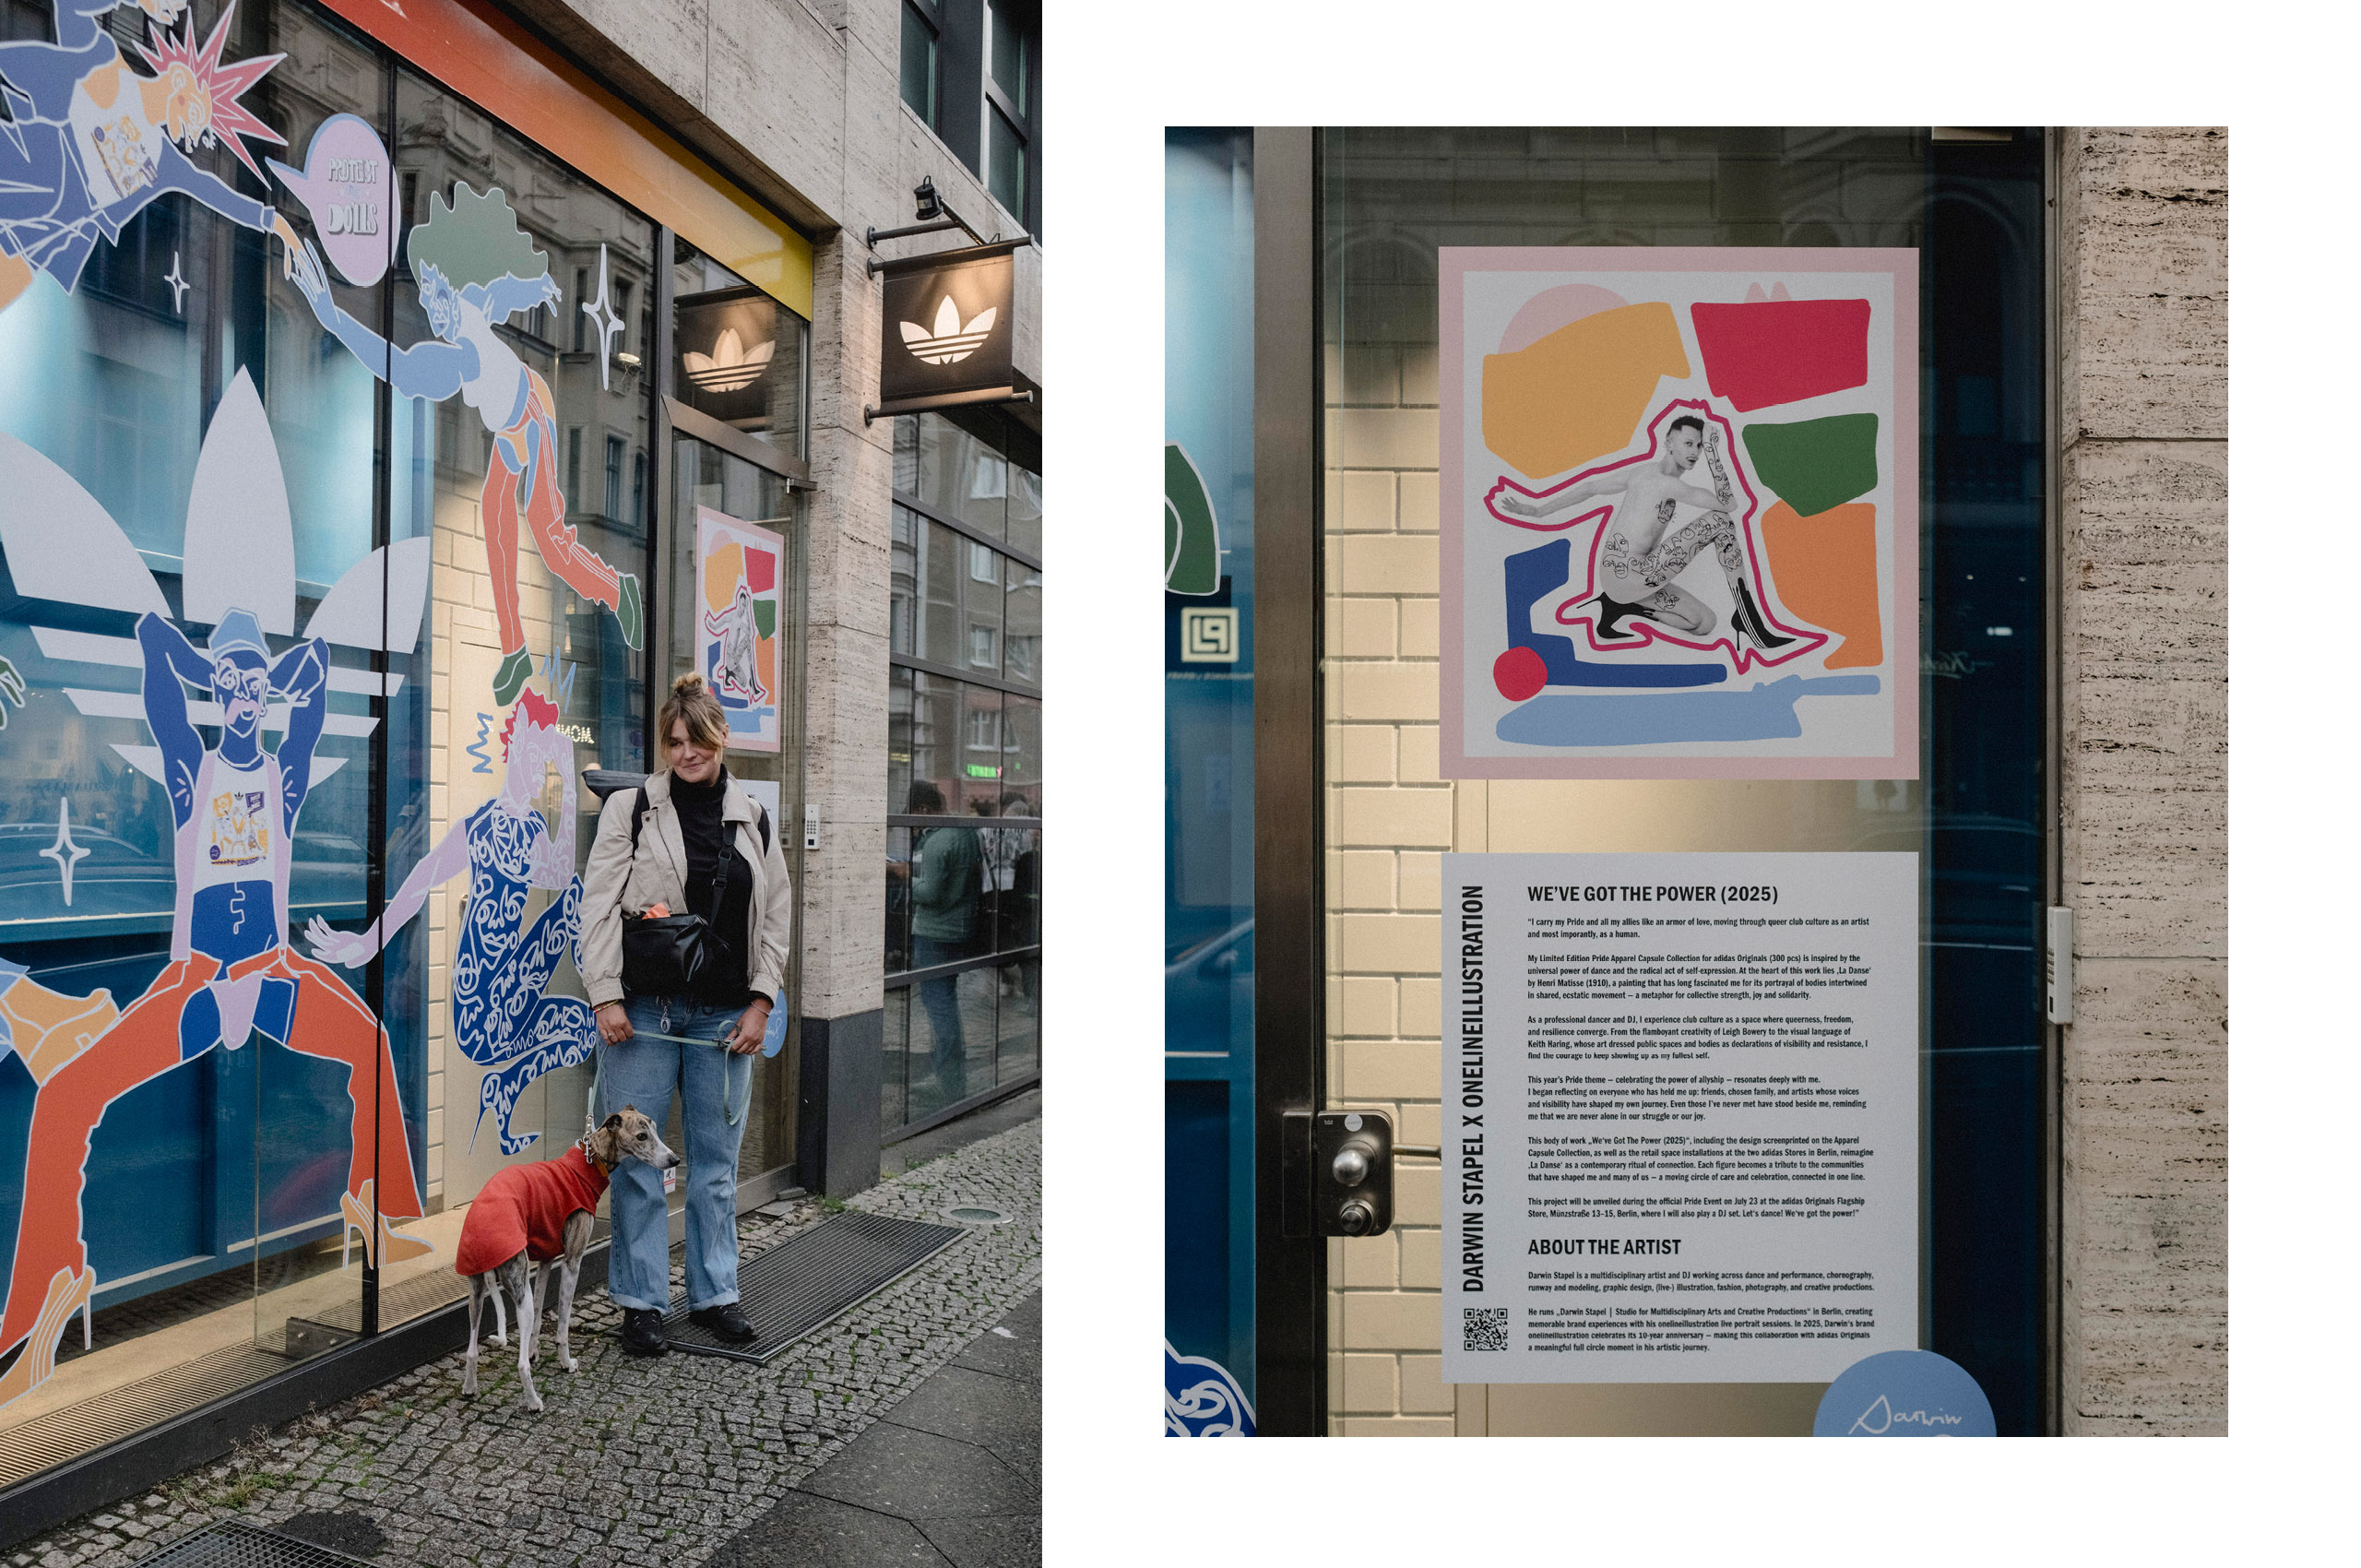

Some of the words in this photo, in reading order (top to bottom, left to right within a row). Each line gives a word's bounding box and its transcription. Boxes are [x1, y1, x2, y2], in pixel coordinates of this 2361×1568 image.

[328, 156, 378, 184] PROTECT
[327, 201, 378, 234] DOLLS
[1527, 886, 1580, 901] WE’VE
[1584, 886, 1618, 901] GOT
[1619, 886, 1653, 901] THE
[1656, 886, 1716, 901] POWER
[1721, 886, 1778, 905] (2025)
[1713, 918, 1738, 927] moving
[1739, 918, 1767, 927] through
[1527, 955, 1538, 964] My
[1610, 955, 1636, 964] Apparel
[1638, 955, 1665, 963] Capsule
[1737, 955, 1768, 964] Originals
[1769, 955, 1786, 963] (300
[1786, 955, 1801, 963] pcs)
[1810, 955, 1838, 963] inspired
[1839, 955, 1848, 963] by
[1462, 885, 1484, 1108] ONELINEILLUSTRATION
[1544, 1016, 1586, 1025] professional
[1627, 1016, 1638, 1024] DJ,
[1643, 1016, 1681, 1025] experience
[1823, 1016, 1854, 1024] freedom,
[1532, 1088, 1553, 1097] began
[1554, 1088, 1588, 1097] reflecting
[1701, 1087, 1727, 1096] friends,
[1753, 1087, 1776, 1097] family,
[1462, 1114, 1484, 1128] X
[1642, 1112, 1670, 1122] struggle
[1693, 1112, 1706, 1122] joy.
[1462, 1133, 1484, 1206] STAPEL
[1543, 1198, 1568, 1206] project
[1622, 1198, 1645, 1206] during
[1734, 1197, 1748, 1206] July
[1805, 1197, 1835, 1206] Originals
[1836, 1197, 1866, 1206] Flagship
[1462, 1212, 1484, 1292] DARWIN
[1527, 1240, 1585, 1254] ABOUT
[1587, 1240, 1620, 1254] THE
[1622, 1240, 1682, 1254] ARTIST
[1553, 1272, 1575, 1280] Stapel
[1590, 1272, 1646, 1280] multidisciplinary
[1691, 1272, 1720, 1280] working
[1781, 1271, 1825, 1280] performance,
[1826, 1271, 1874, 1280] choreography,
[1568, 1284, 1601, 1292] modeling,
[1602, 1284, 1629, 1292] graphic
[1629, 1284, 1655, 1292] design,
[1745, 1284, 1789, 1292] photography,
[1833, 1284, 1875, 1292] productions.
